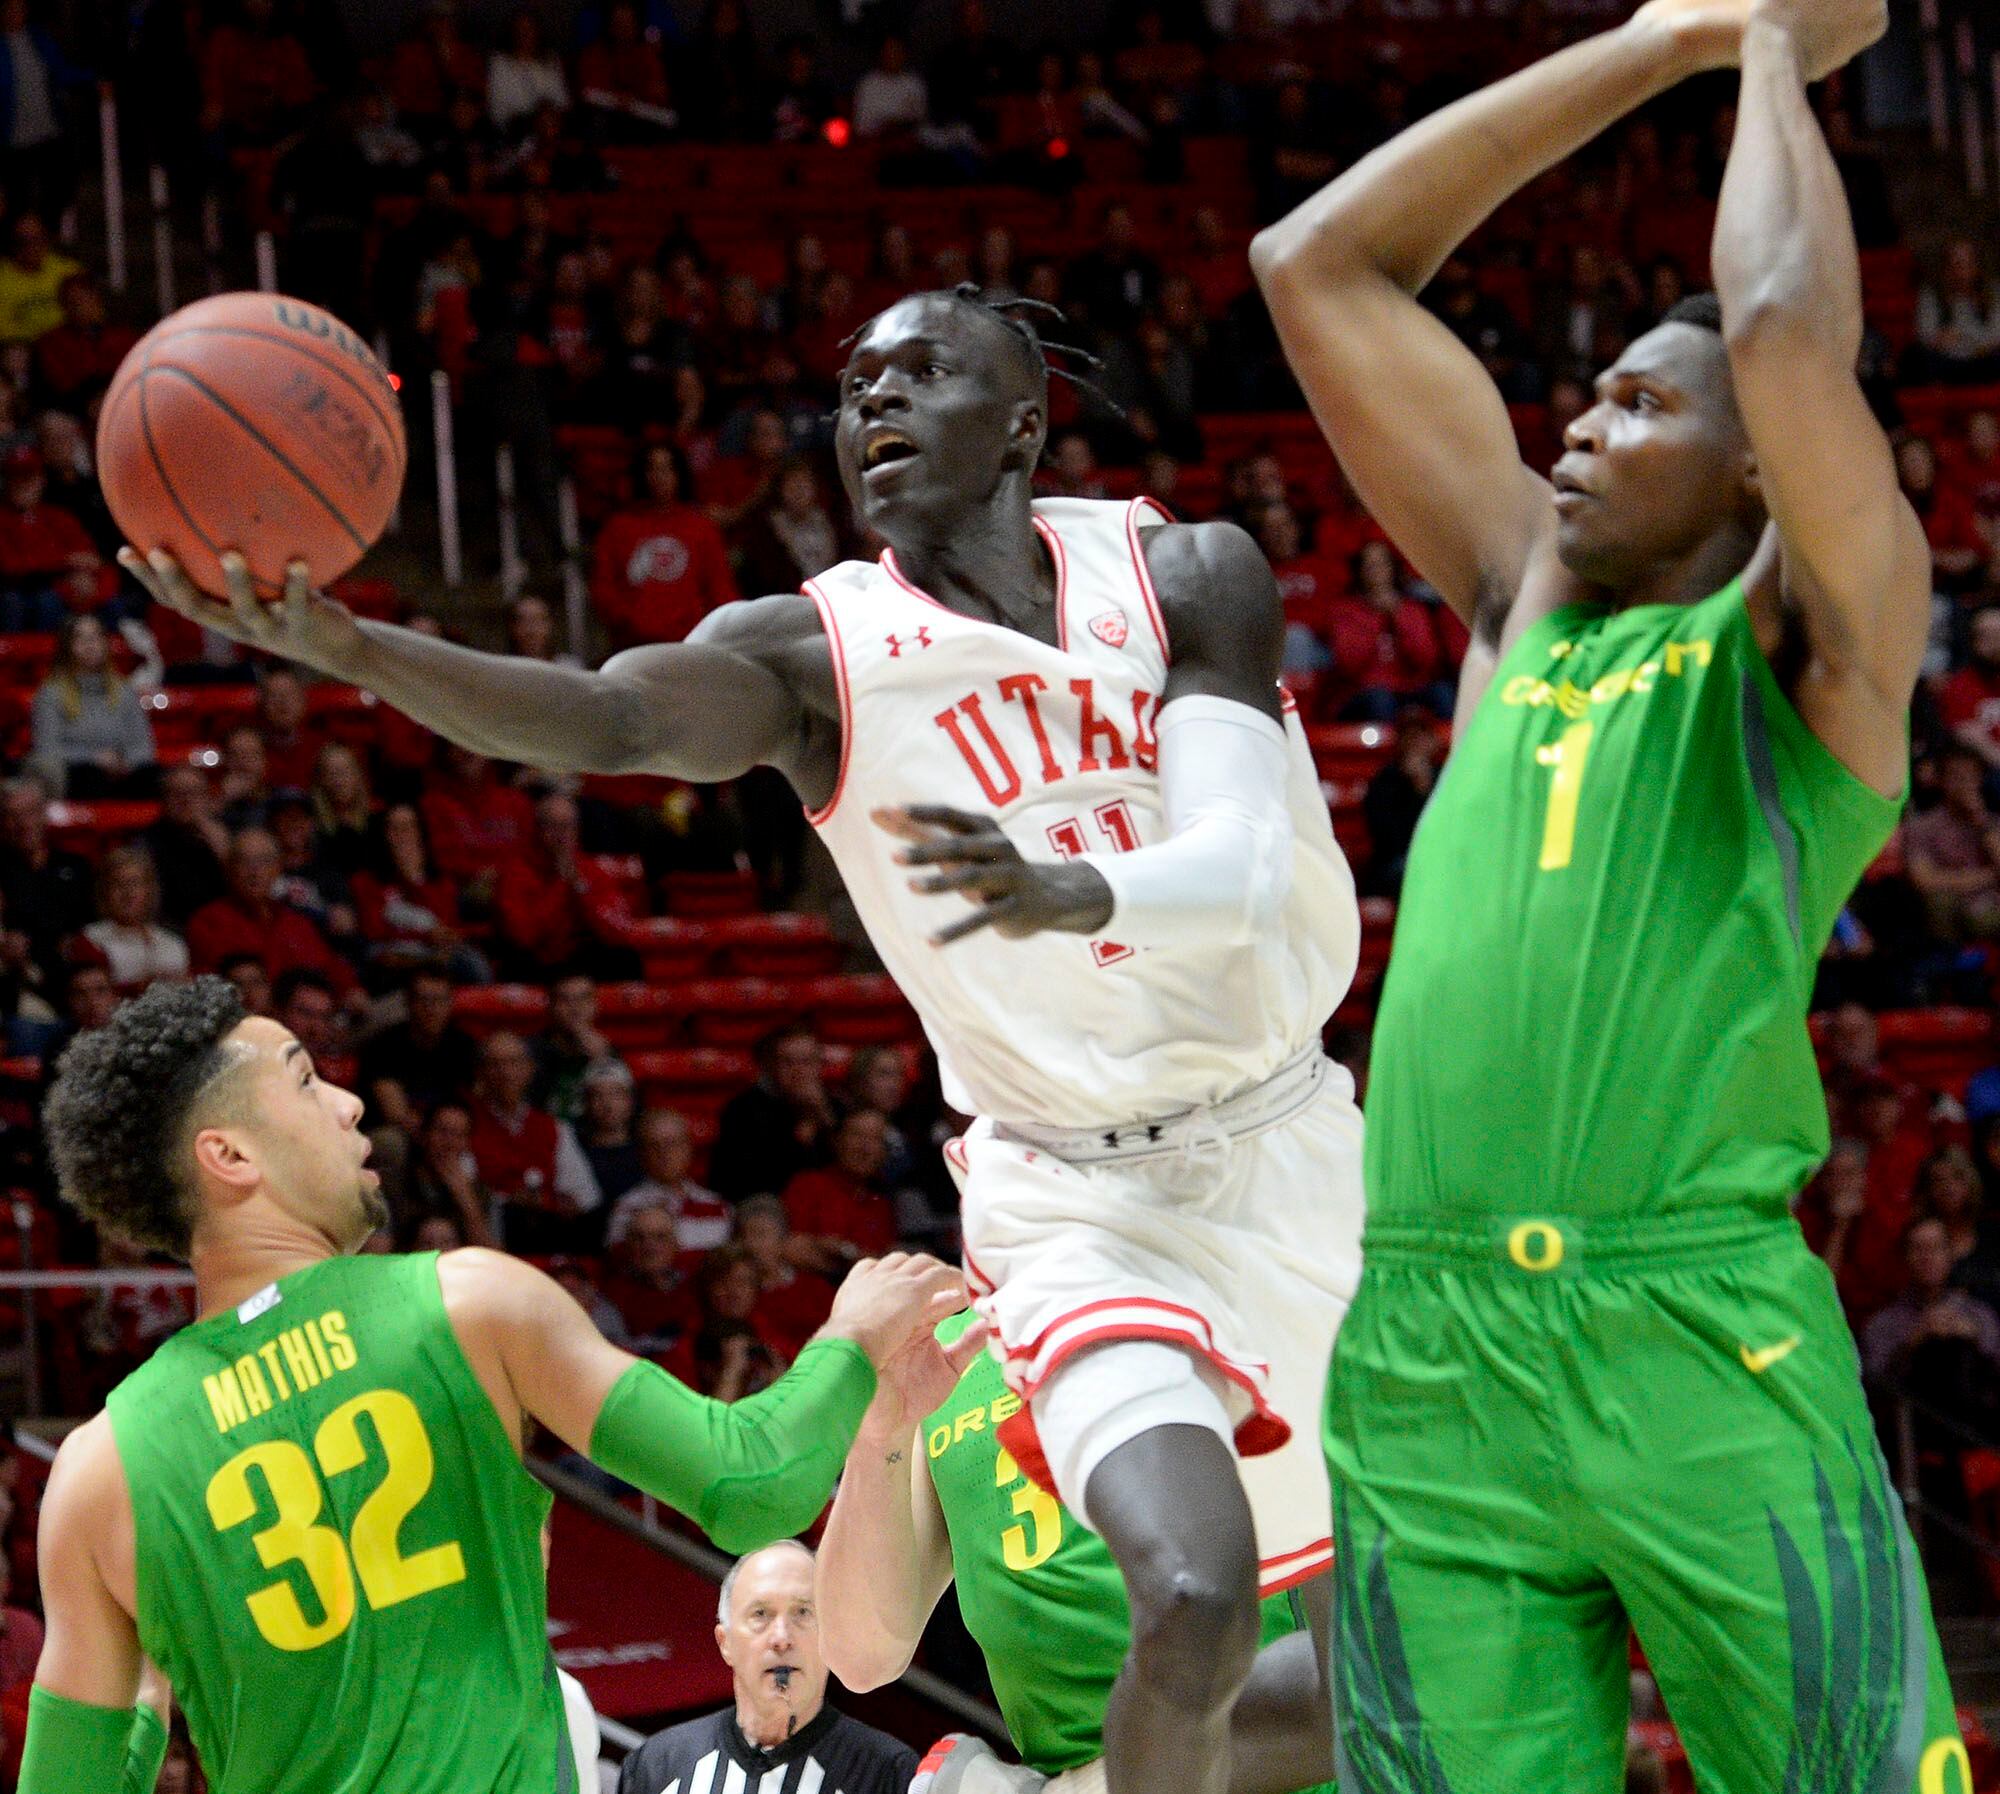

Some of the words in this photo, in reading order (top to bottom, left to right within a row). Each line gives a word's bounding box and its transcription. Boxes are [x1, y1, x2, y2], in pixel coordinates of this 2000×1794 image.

[1536, 720, 1593, 870] 1
[1508, 1221, 1564, 1271] O
[203, 1310, 358, 1434] MATHIS
[928, 1393, 1023, 1459] ORE
[206, 1388, 467, 1653] 32
[996, 1448, 1062, 1571] 3
